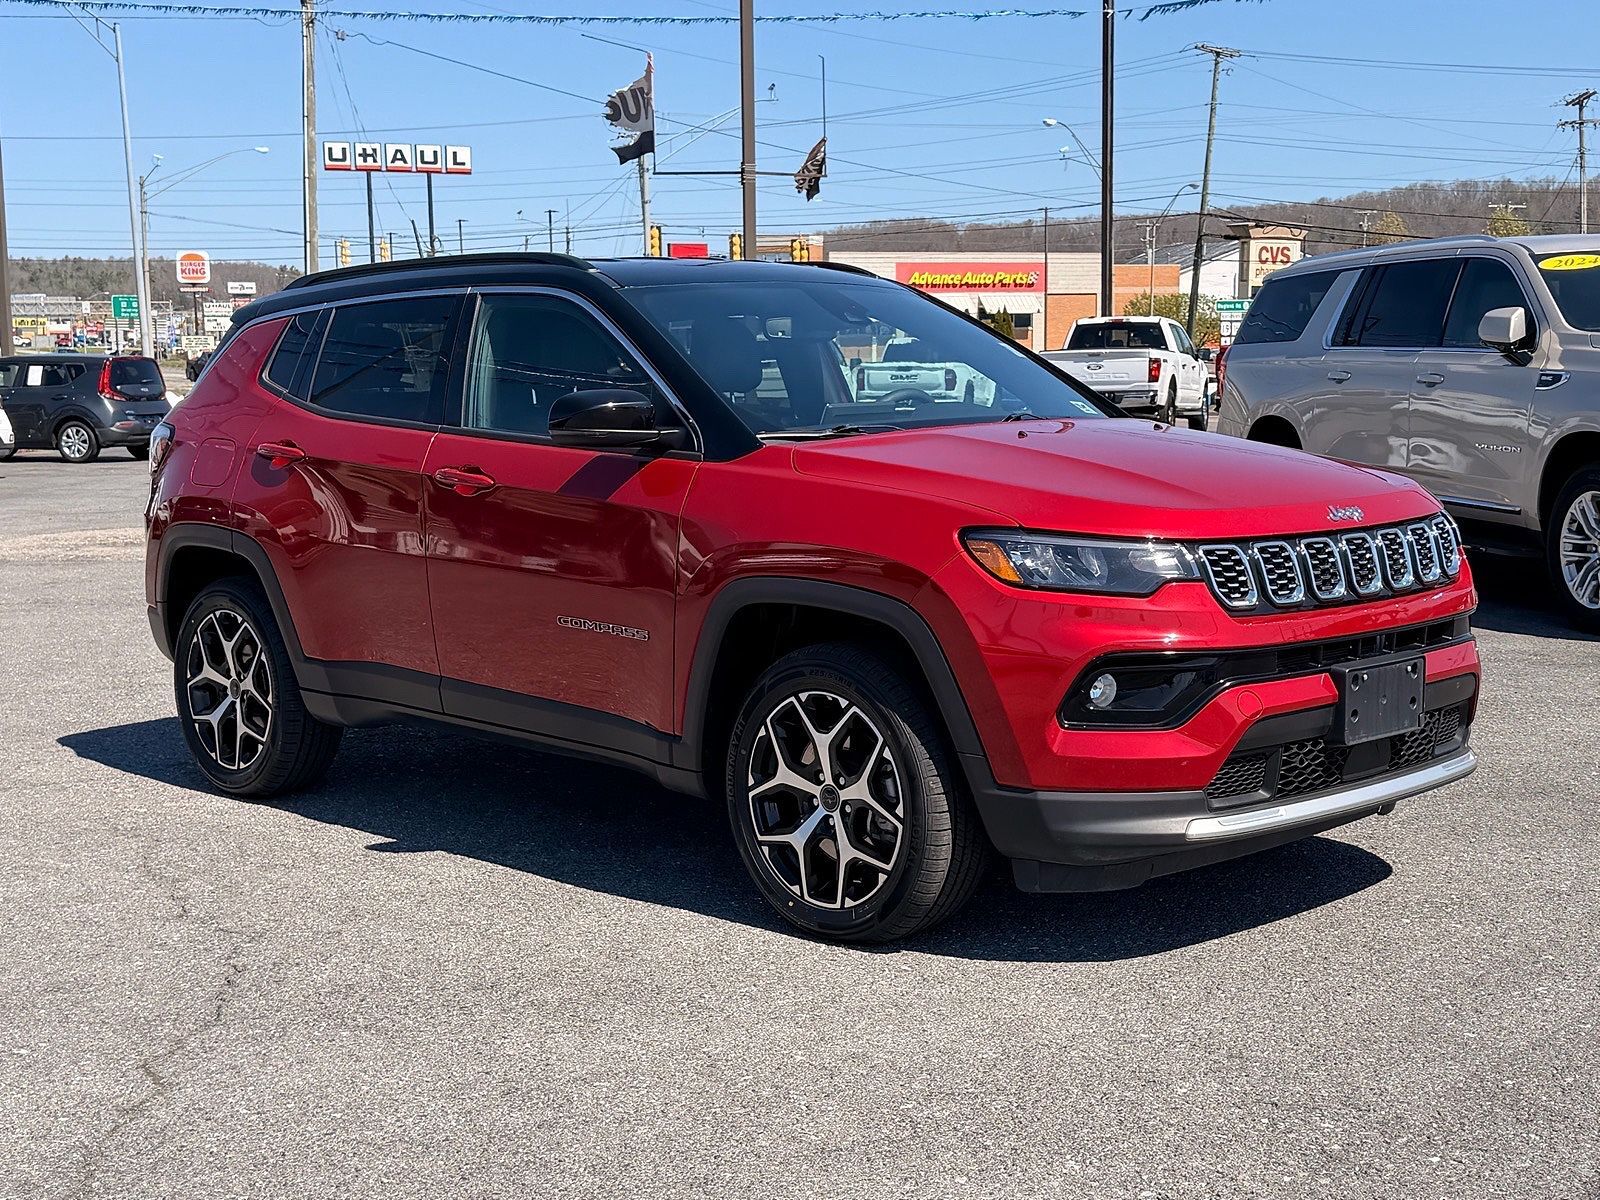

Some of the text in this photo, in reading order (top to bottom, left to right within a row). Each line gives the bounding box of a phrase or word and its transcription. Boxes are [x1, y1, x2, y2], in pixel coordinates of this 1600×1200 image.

[1258, 245, 1291, 265] CVS
[1553, 256, 1599, 268] 2024
[180, 267, 206, 276] KING
[1255, 267, 1276, 278] phar
[909, 272, 1029, 284] Advance Auto Parts
[1475, 443, 1521, 453] YUKON
[1327, 505, 1364, 522] Jeep
[556, 615, 650, 641] COMPASS
